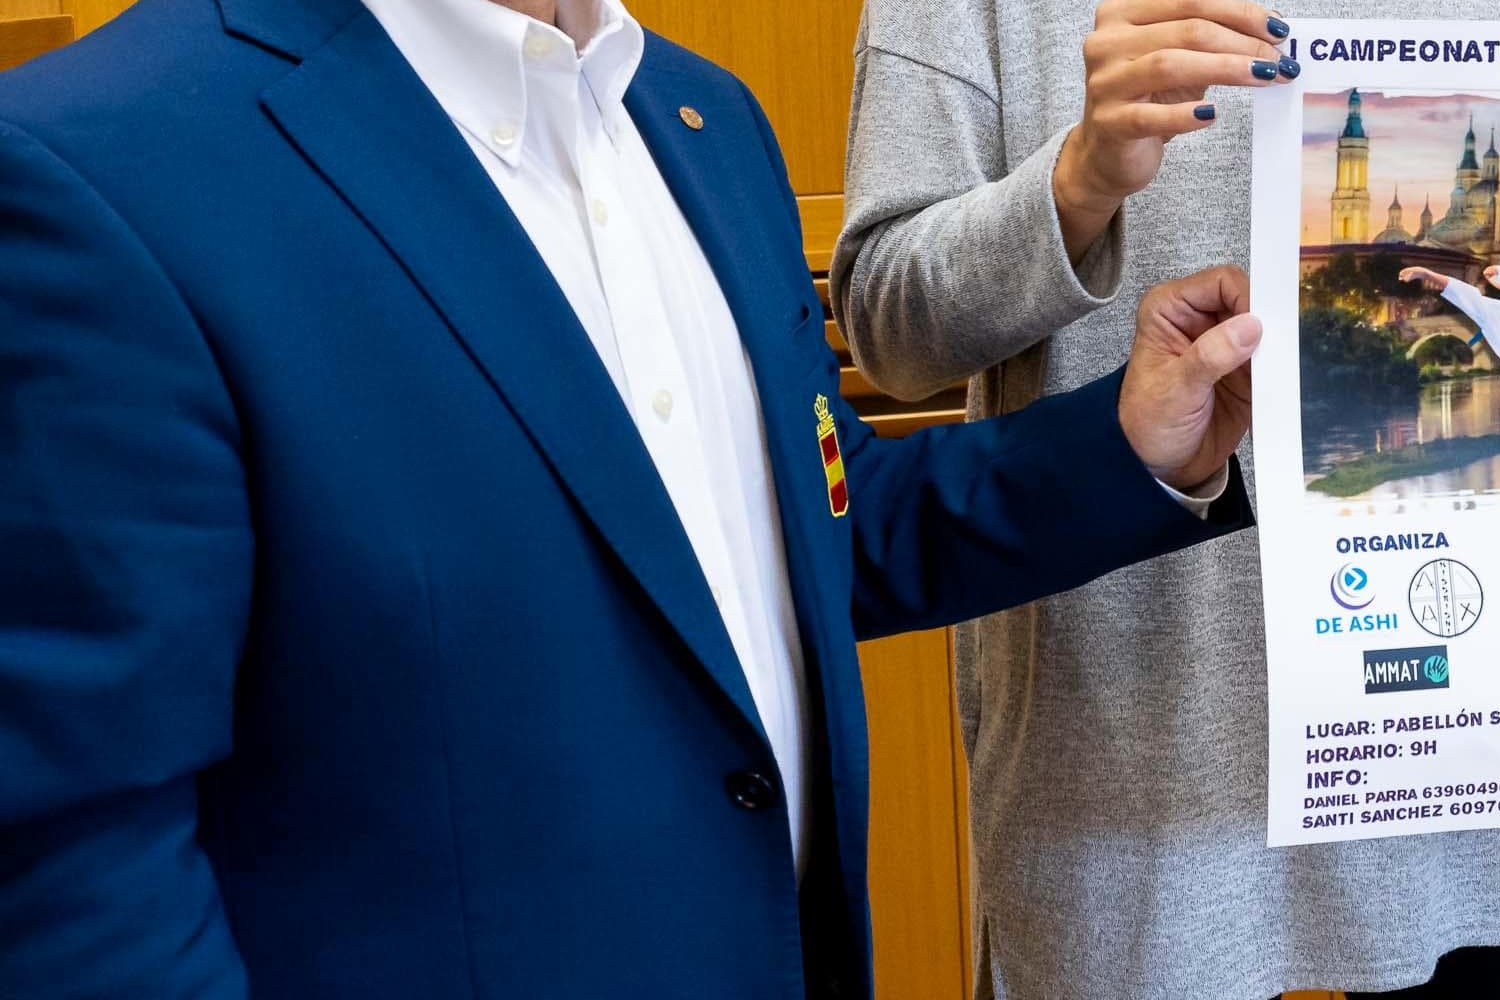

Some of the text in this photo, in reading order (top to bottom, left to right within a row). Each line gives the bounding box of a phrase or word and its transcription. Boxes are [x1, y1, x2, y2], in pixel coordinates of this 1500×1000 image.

[1289, 39, 1297, 60] I
[1336, 532, 1449, 554] ORGANIZA
[1315, 613, 1398, 634] DE ASHI
[1364, 659, 1421, 685] AMMAT
[1306, 720, 1376, 739] LUGAR:
[1383, 708, 1482, 734] PABELLÓN
[1306, 740, 1437, 764] HORARIO: 9H
[1306, 769, 1368, 789] INFO:
[1304, 793, 1359, 809] DANIEL
[1365, 789, 1418, 804] PARRA
[1302, 812, 1354, 829] SANTI
[1360, 804, 1443, 824] SANCHEZ
